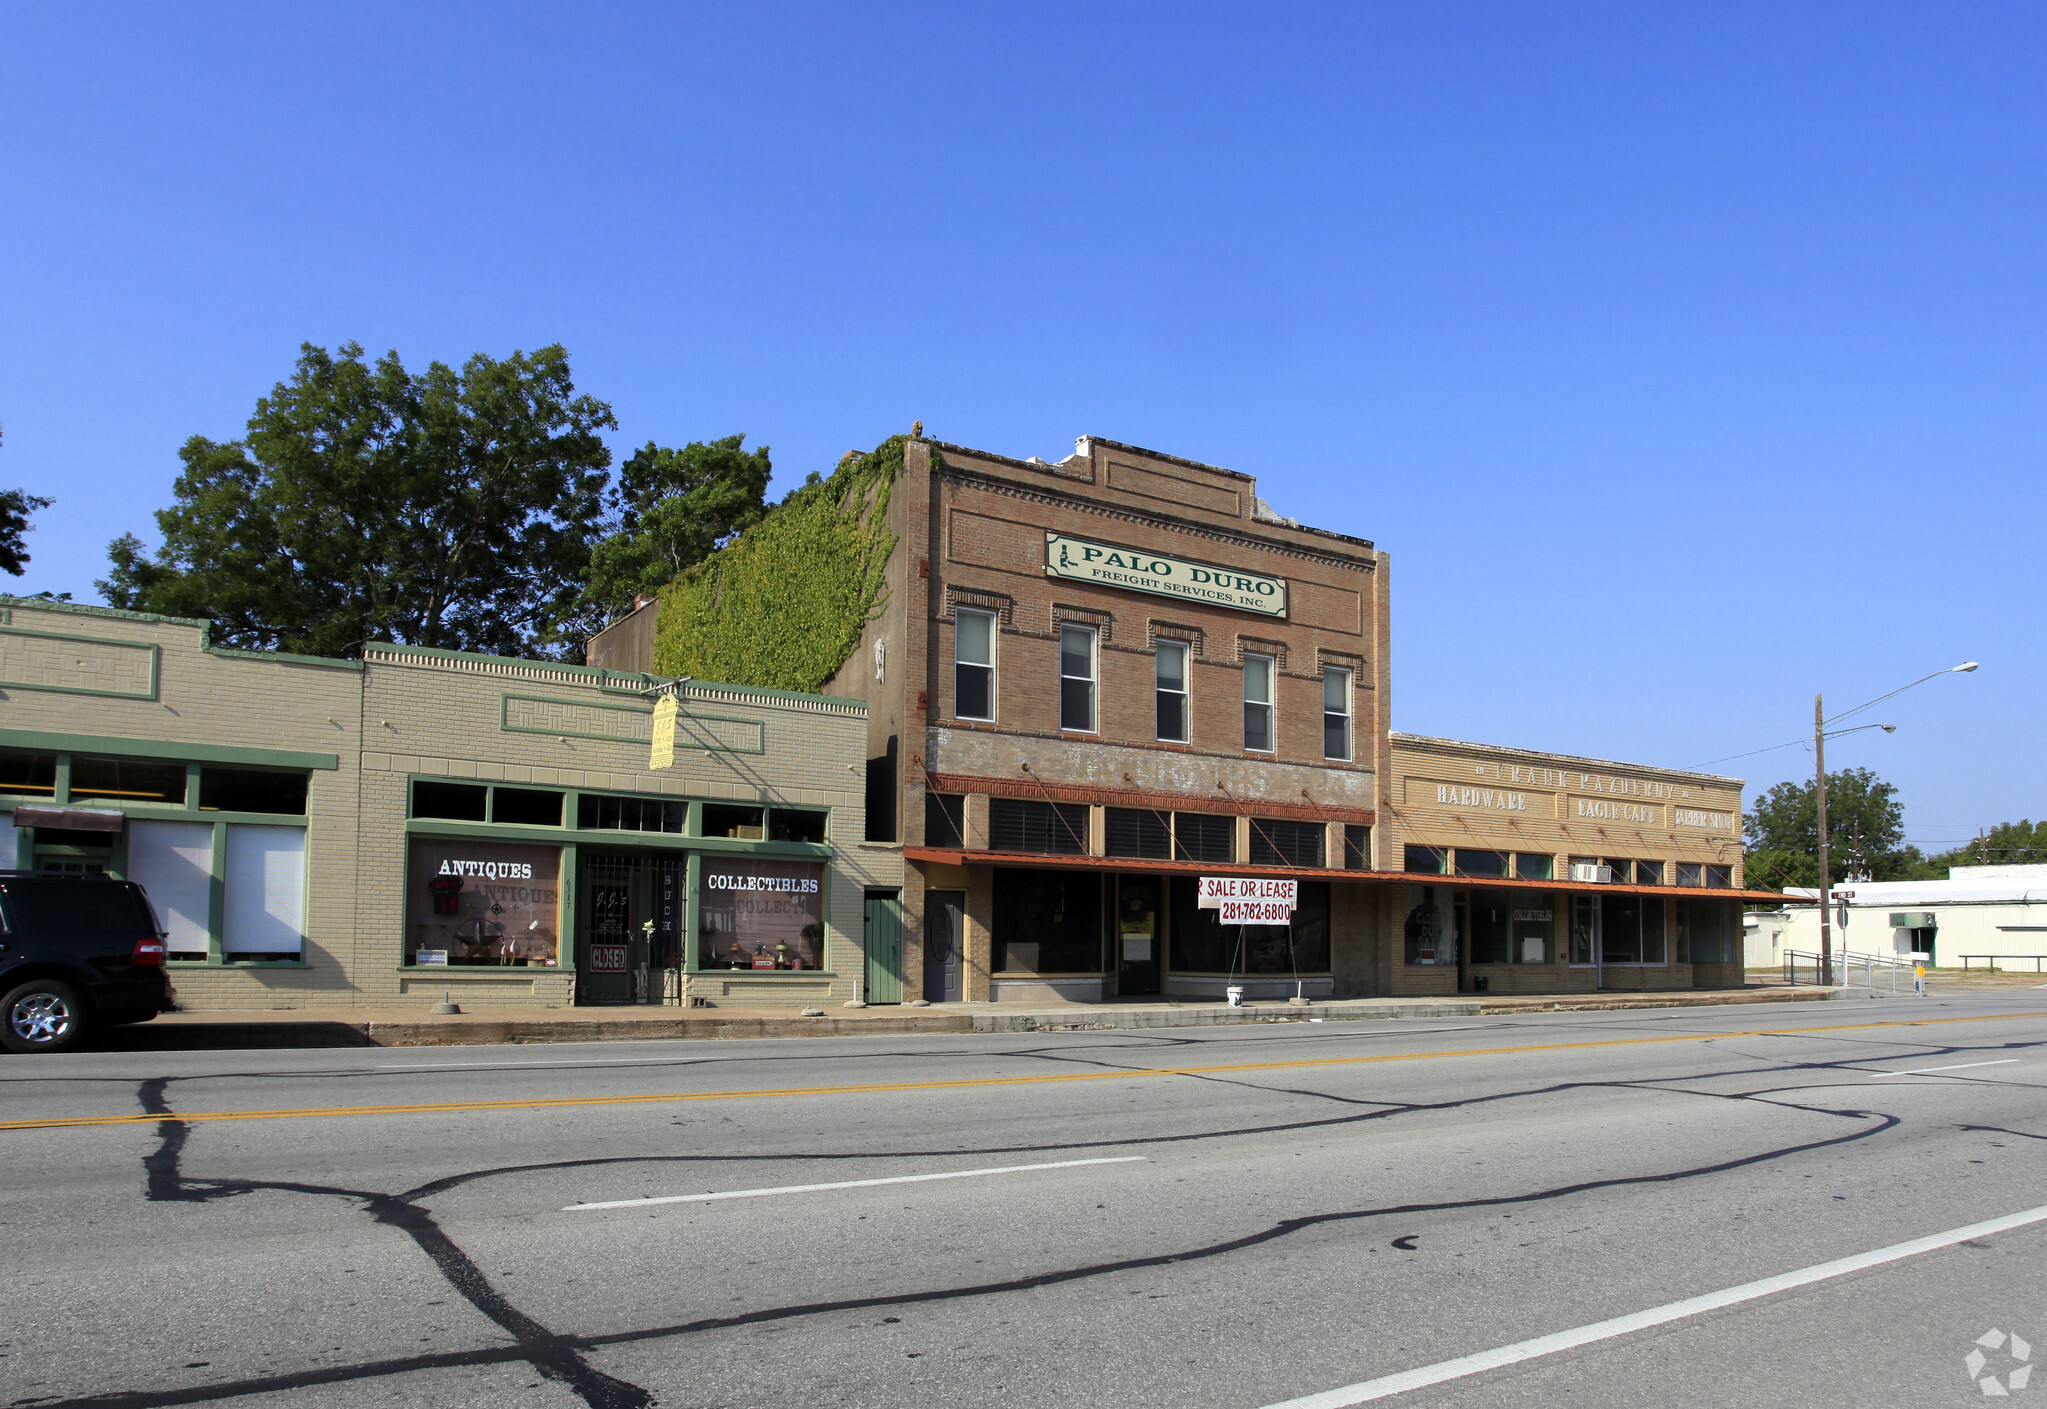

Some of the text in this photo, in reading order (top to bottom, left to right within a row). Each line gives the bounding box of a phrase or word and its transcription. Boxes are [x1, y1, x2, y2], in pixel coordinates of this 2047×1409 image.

[1081, 546, 1275, 596] PALO DURO
[1091, 568, 1267, 609] FREIGHT SERVICES, INC.
[1496, 763, 1569, 788] FRANK
[1580, 772, 1675, 801] PAZDERNY
[1437, 784, 1527, 812] HARDWARE
[1578, 799, 1656, 825] EAGLE CAFE
[439, 860, 532, 880] ANTIQUES
[708, 874, 819, 893] COLLECTIBLES
[1207, 880, 1236, 897] SALE
[1240, 881, 1257, 897] OR
[1260, 881, 1295, 899] LEASE
[592, 948, 625, 968] CLOSED
